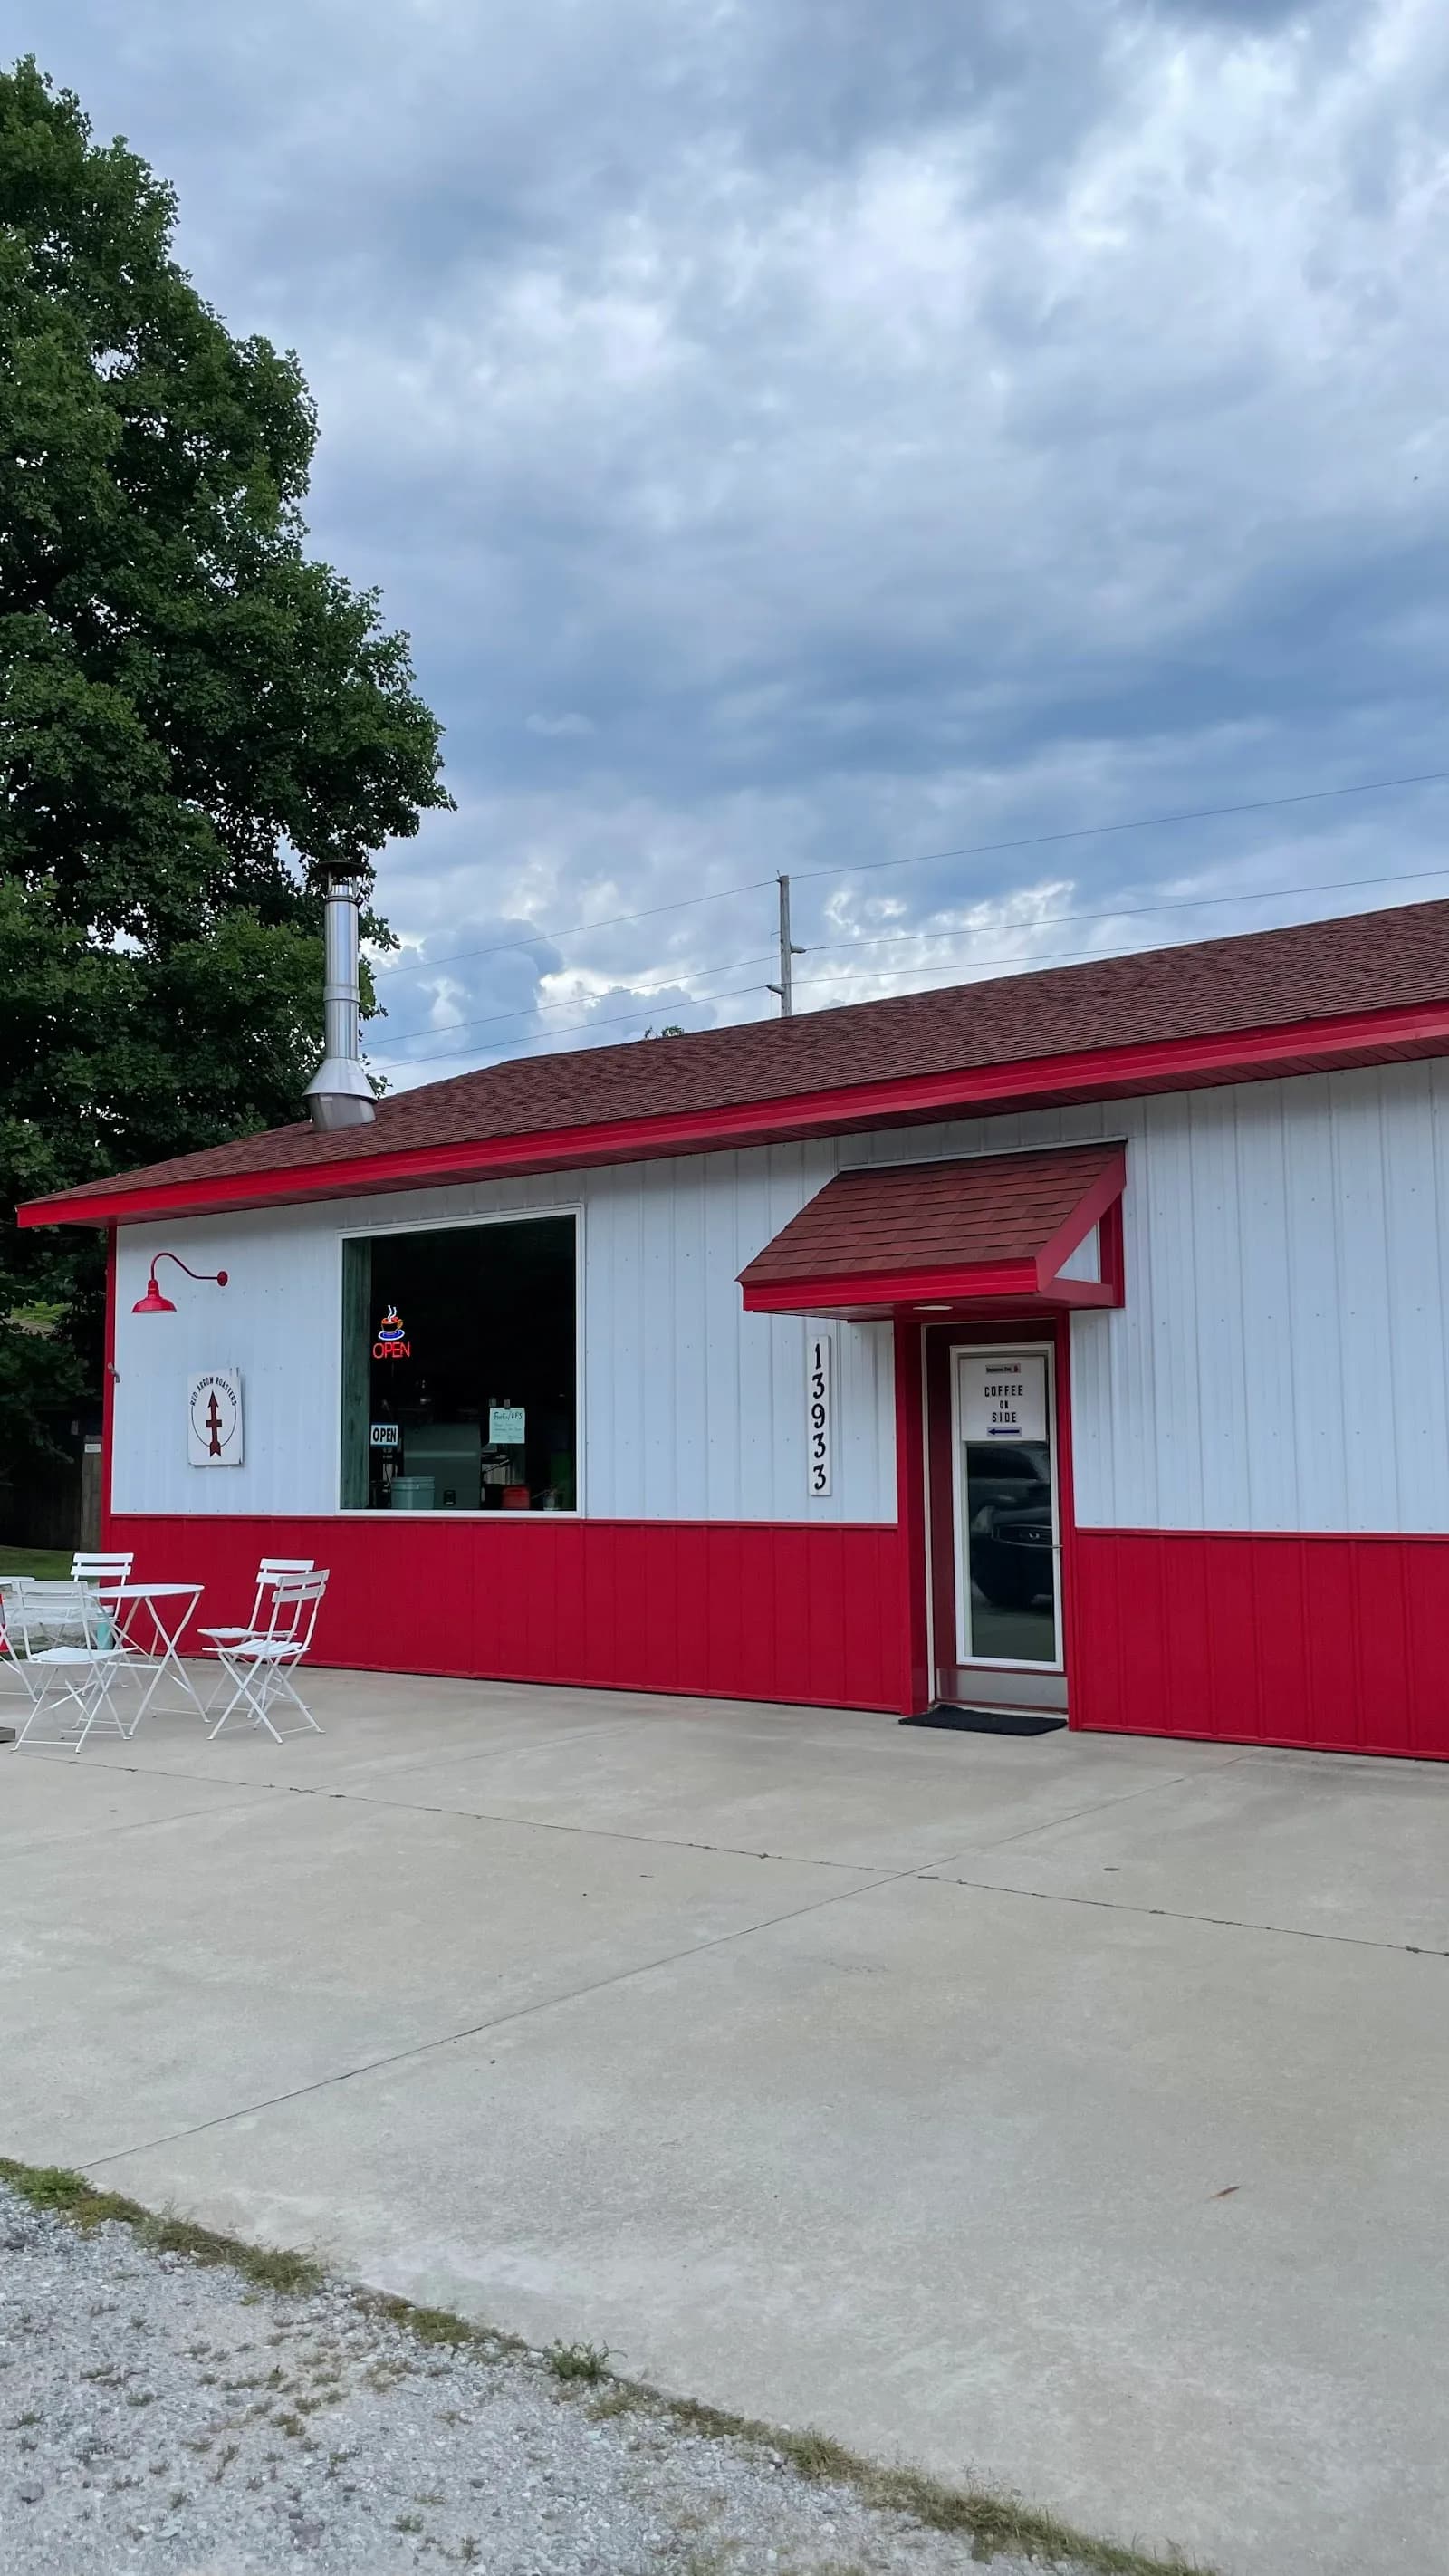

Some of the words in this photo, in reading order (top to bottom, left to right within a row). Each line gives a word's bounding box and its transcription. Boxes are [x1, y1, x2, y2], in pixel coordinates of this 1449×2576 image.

[372, 1341, 410, 1359] OPEN
[189, 1391, 198, 1406] RED
[197, 1377, 214, 1391] ARROW
[216, 1377, 237, 1406] ROASTERS
[984, 1385, 1022, 1397] COFFEE
[999, 1400, 1009, 1409] ON
[811, 1343, 827, 1490] 13933
[992, 1412, 1016, 1423] SIDE
[372, 1427, 397, 1443] OPEN
